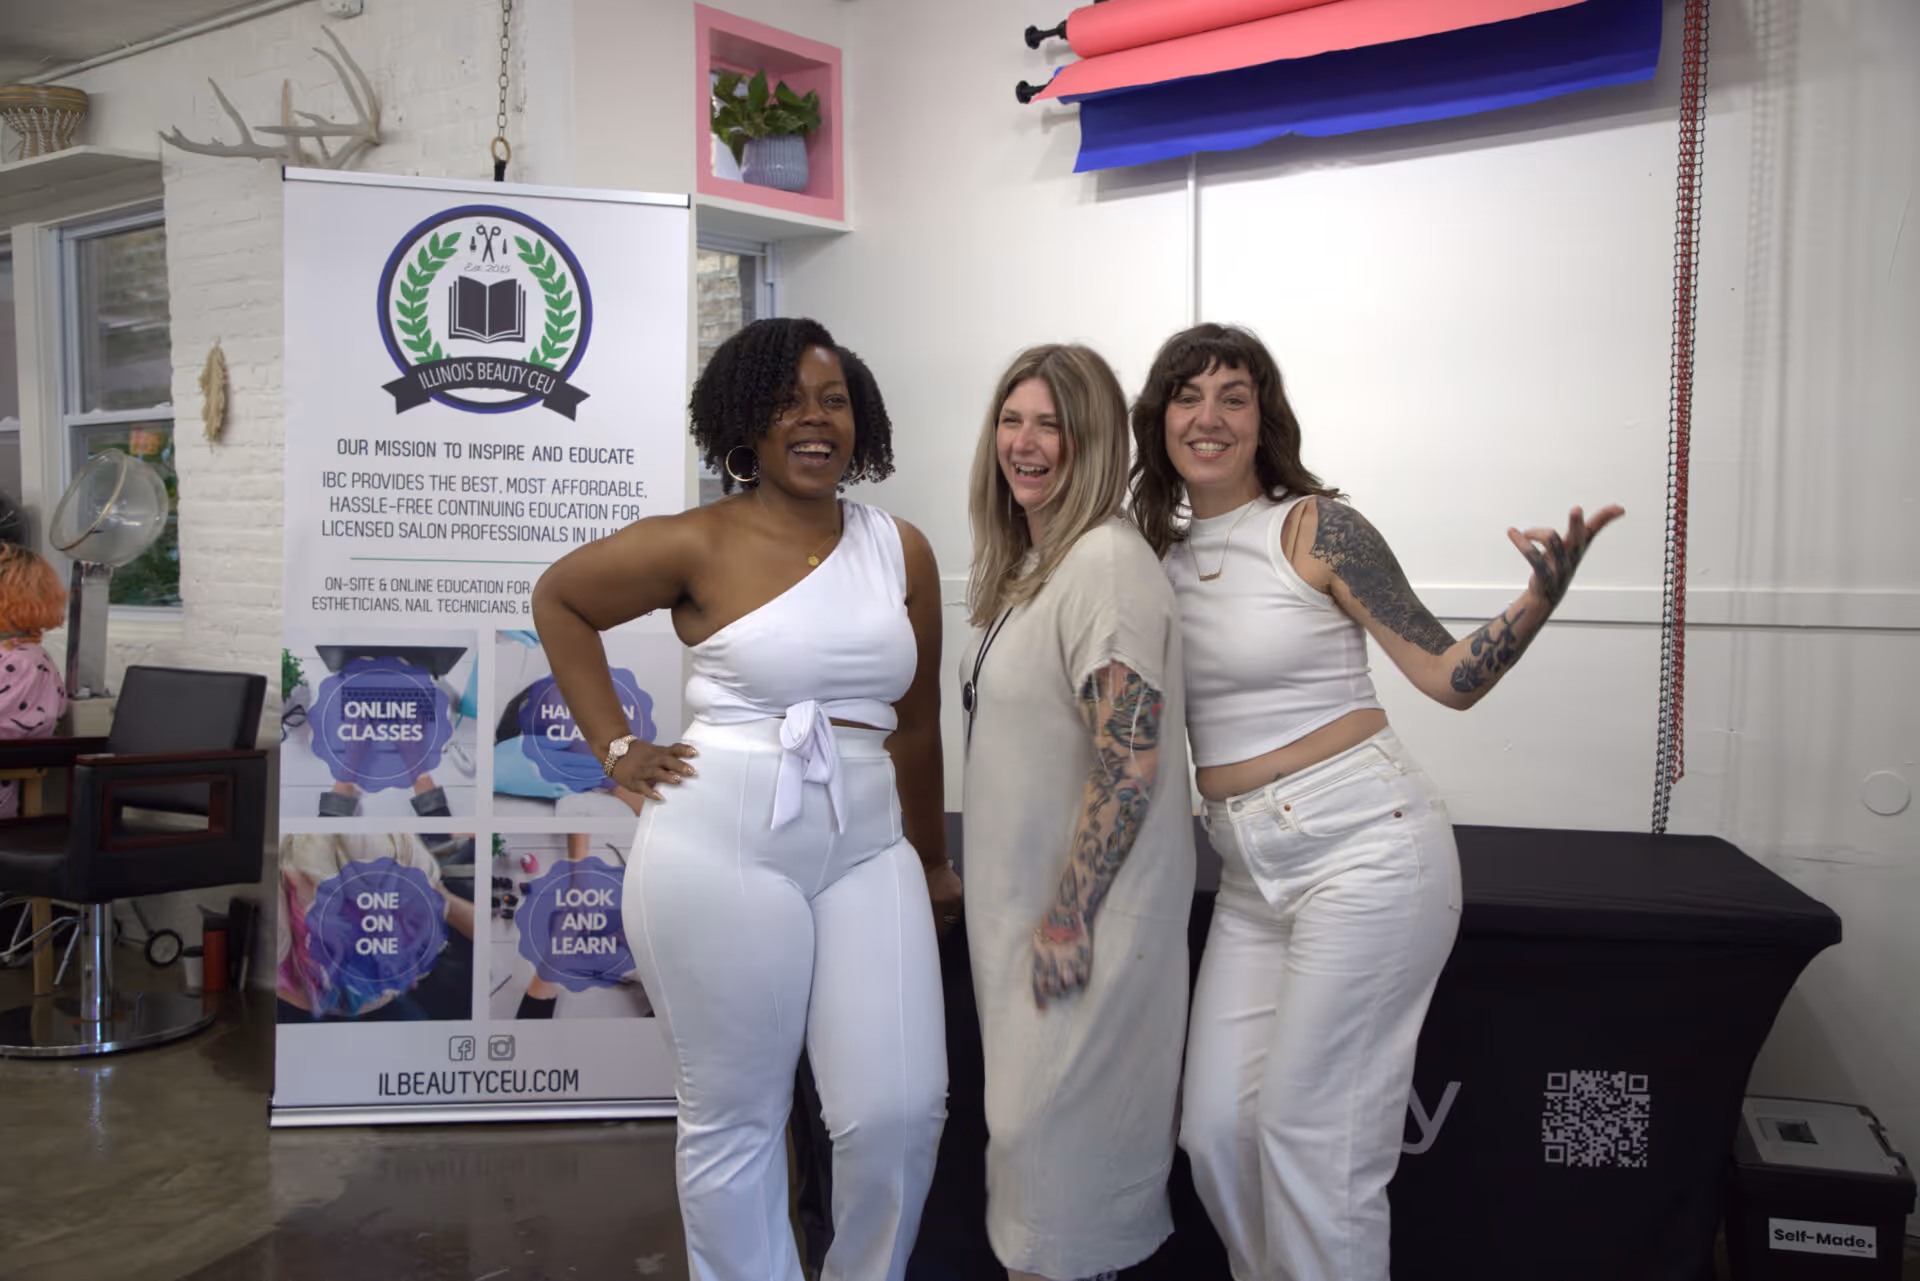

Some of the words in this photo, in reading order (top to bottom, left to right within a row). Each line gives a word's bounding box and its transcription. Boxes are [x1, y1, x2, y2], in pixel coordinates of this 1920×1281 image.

[418, 362, 474, 390] ILLINOIS
[477, 361, 528, 385] BEAUTY
[527, 370, 556, 394] CEU
[337, 438, 368, 456] OUR
[374, 439, 436, 458] MISSION
[443, 441, 462, 459] TO
[468, 443, 525, 461] INSPIRE
[532, 445, 563, 463] AND
[569, 446, 635, 465] EDUCATE
[322, 471, 347, 488] IBC
[351, 472, 425, 491] PROVIDES
[428, 474, 457, 492] THE
[506, 477, 546, 495] MOST
[551, 478, 648, 499] AFFORDABLE,
[329, 496, 433, 515] HASSLE-FREE
[438, 499, 525, 518] CONTINUING
[529, 501, 608, 520] EDUCATION
[612, 504, 640, 521] FOR
[321, 519, 394, 539] LICENSED
[398, 521, 447, 540] SALON
[451, 523, 569, 543] PROFESSIONALS
[573, 526, 586, 543] IN
[325, 576, 376, 592] ON-SITE
[379, 577, 387, 592] &
[390, 578, 433, 593] ONLINE
[437, 579, 504, 594] EDUCATION
[405, 598, 433, 613] NAIL
[436, 598, 519, 615] TECHNICIANS,
[522, 601, 530, 614] &
[344, 701, 417, 719] ONLINE
[337, 723, 424, 741] CLASSES
[356, 892, 400, 910] ONE
[556, 888, 615, 907] LOOK
[361, 915, 394, 932] ON
[561, 912, 608, 931] AND
[355, 937, 399, 955] ONE
[552, 936, 617, 955] LEARN
[378, 1069, 580, 1097] ILBEAUTYCEU.COM
[1773, 1228, 1874, 1249] Self-Made.
